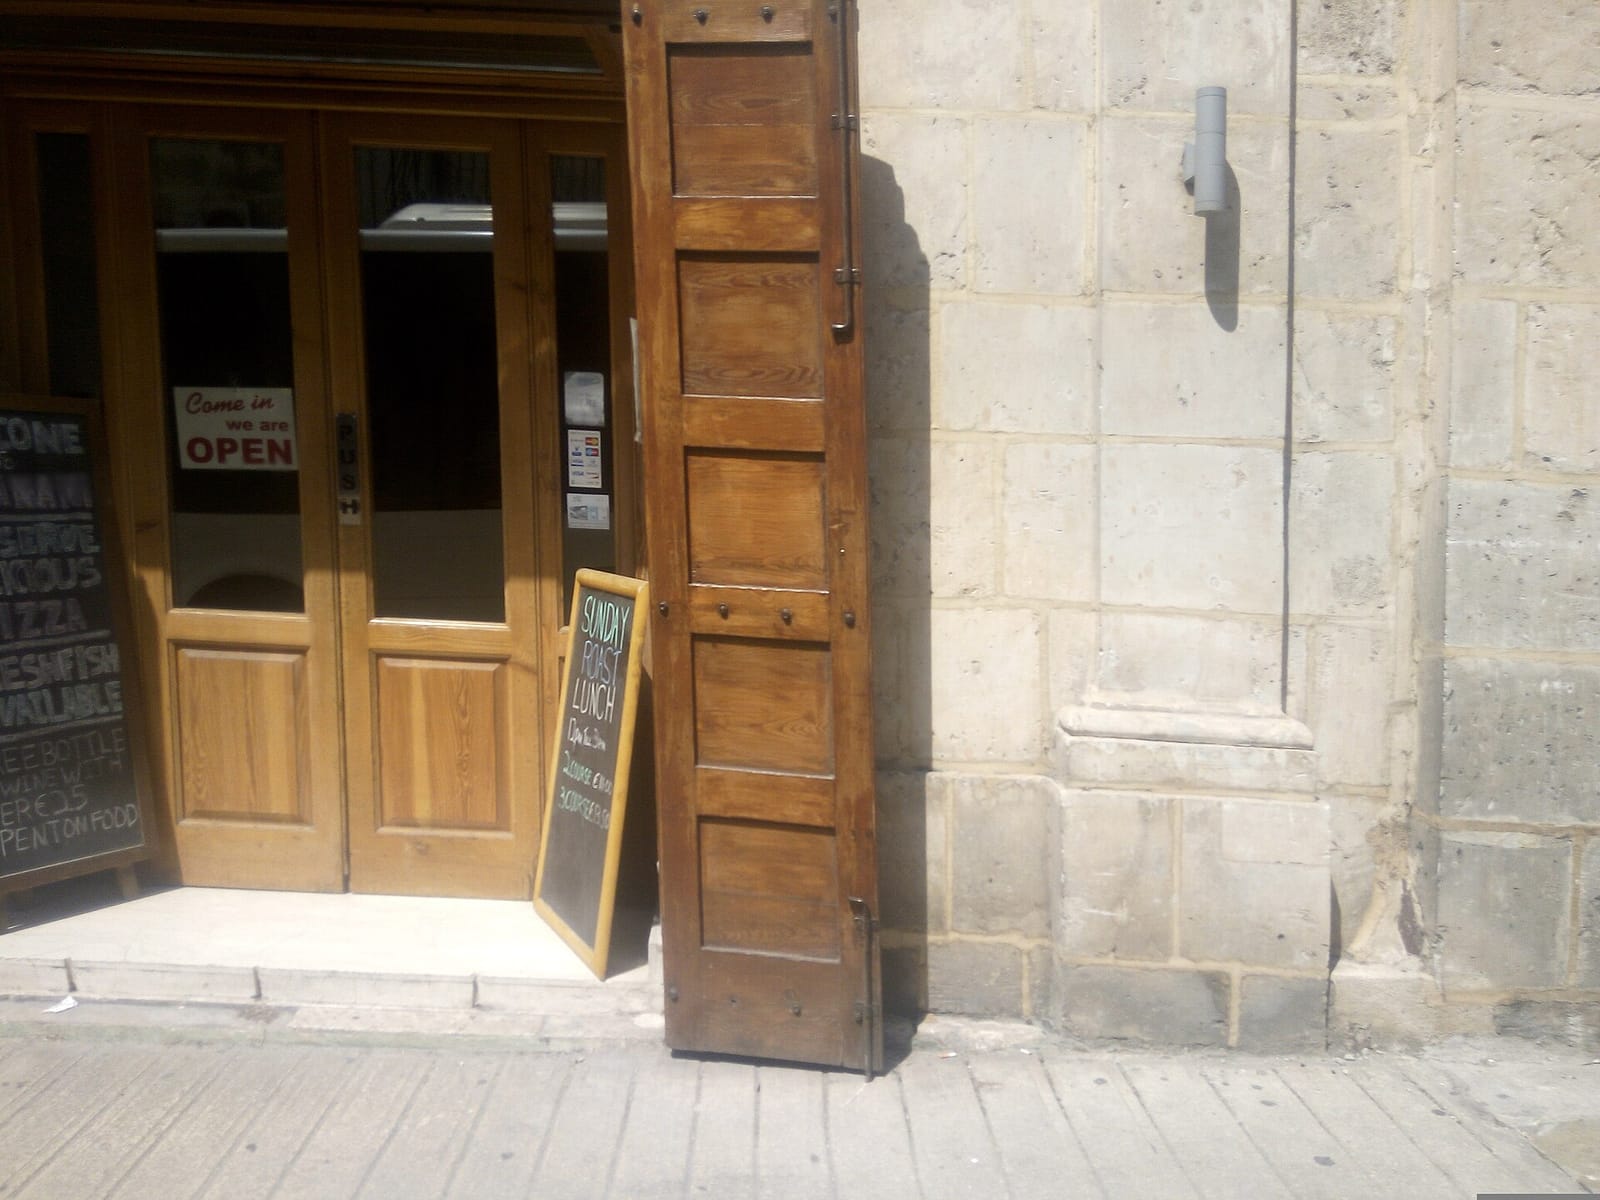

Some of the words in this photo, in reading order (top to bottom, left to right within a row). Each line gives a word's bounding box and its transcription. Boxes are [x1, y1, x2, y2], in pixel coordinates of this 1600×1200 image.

[185, 391, 245, 414] Come
[250, 395, 275, 409] in
[225, 420, 253, 431] we
[259, 421, 289, 432] are
[187, 437, 292, 464] OPEN
[581, 595, 630, 651] SUNDAY
[580, 640, 623, 686] ROAST
[572, 677, 616, 724] LUNCH
[90, 803, 138, 831] FOOD
